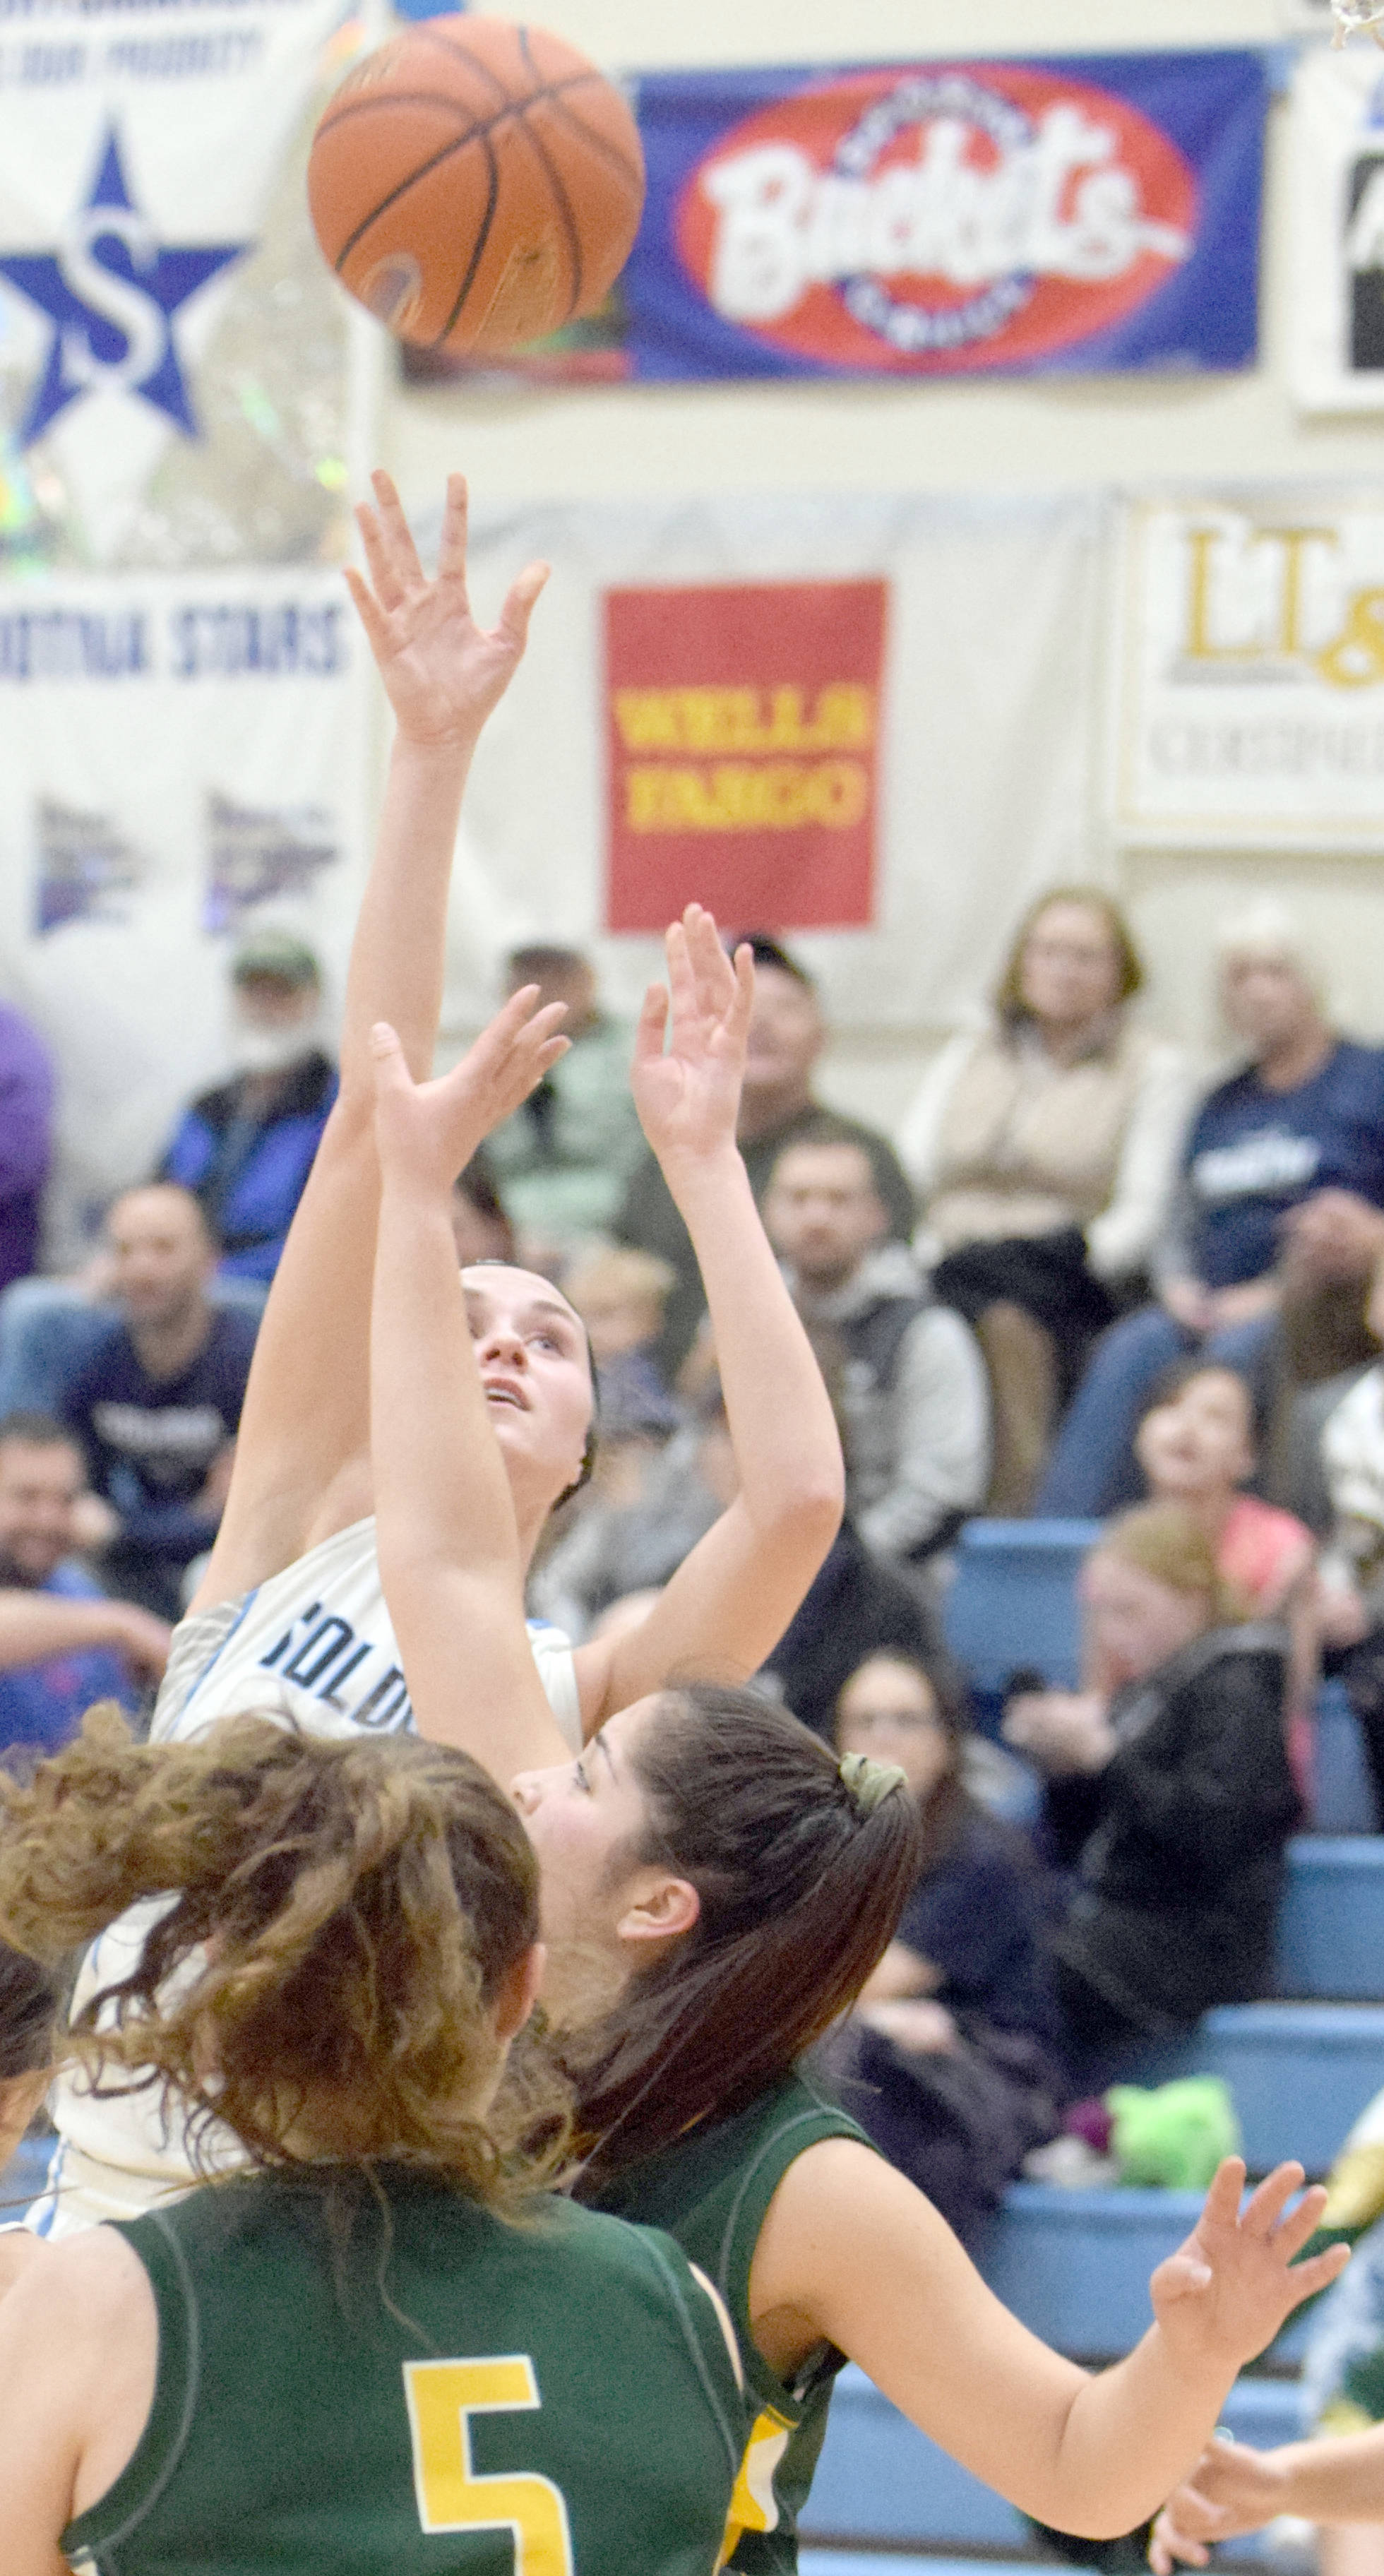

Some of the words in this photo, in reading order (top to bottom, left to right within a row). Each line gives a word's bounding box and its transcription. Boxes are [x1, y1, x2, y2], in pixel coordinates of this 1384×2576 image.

[705, 103, 1193, 322] Buckets
[58, 208, 169, 386] S
[616, 681, 868, 751] WELLS
[628, 764, 867, 833] FARGO
[259, 1602, 414, 1732] SOLD
[402, 2354, 573, 2576] 5
